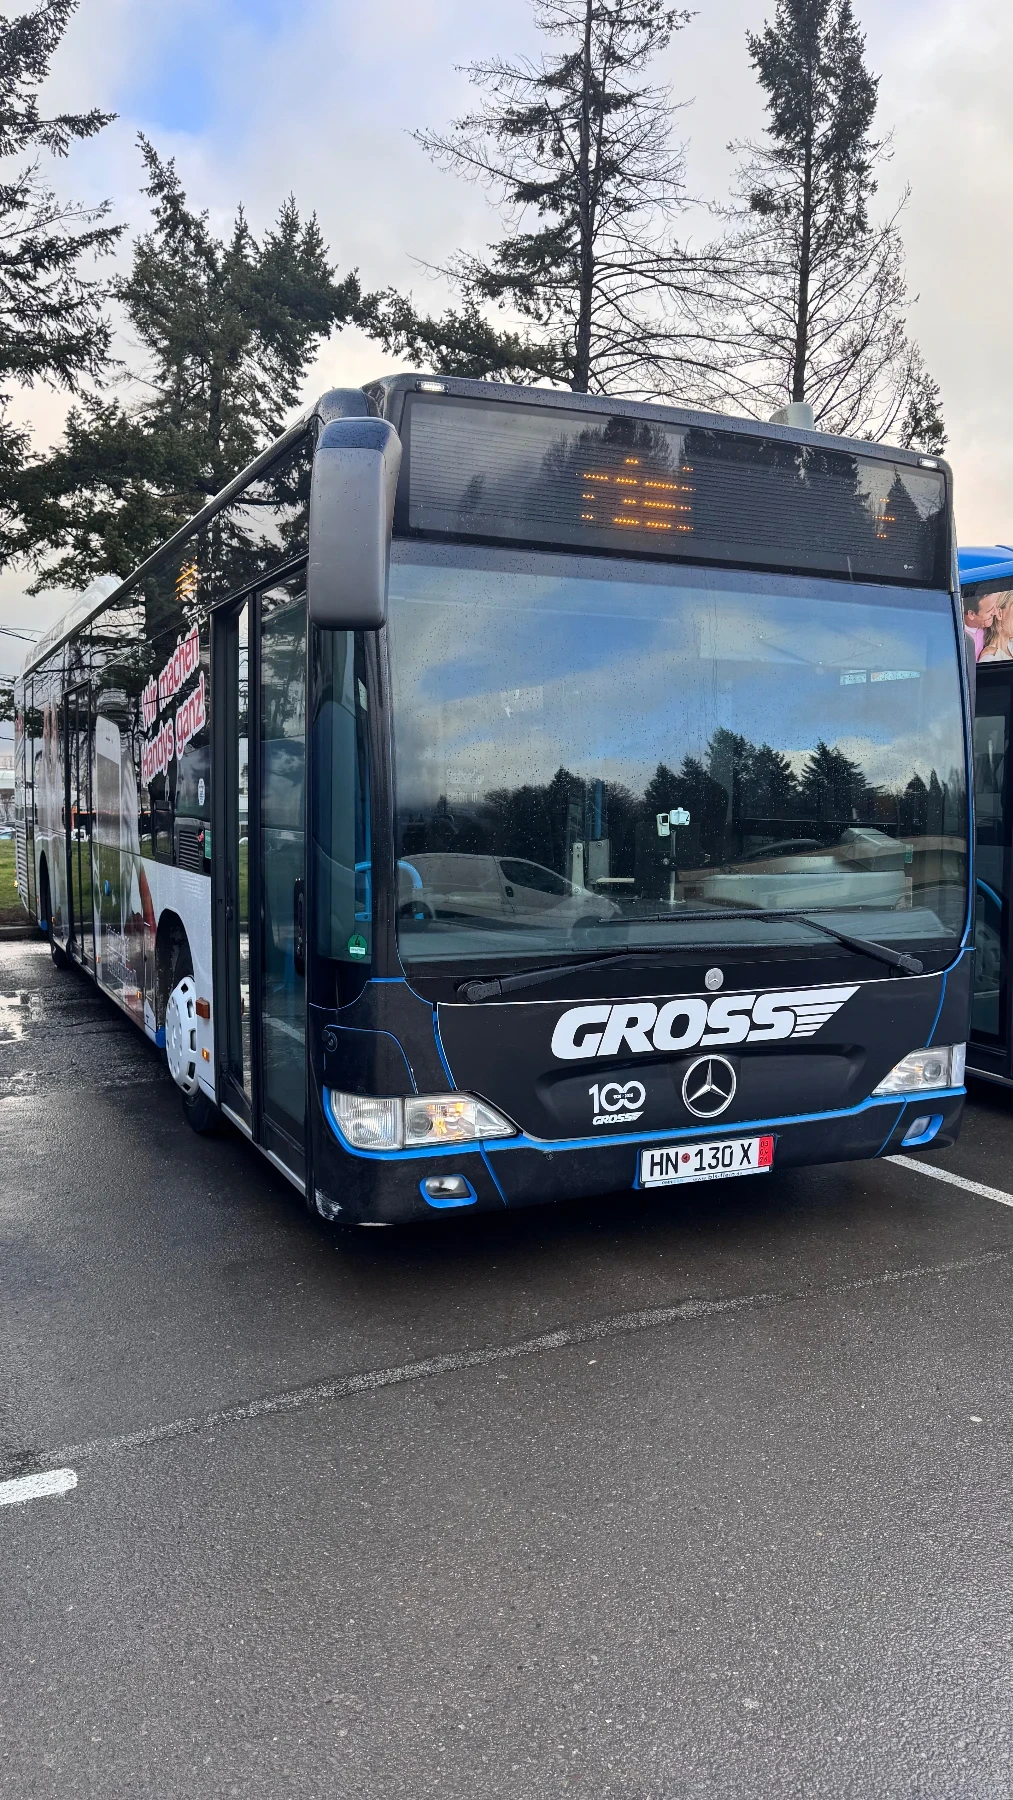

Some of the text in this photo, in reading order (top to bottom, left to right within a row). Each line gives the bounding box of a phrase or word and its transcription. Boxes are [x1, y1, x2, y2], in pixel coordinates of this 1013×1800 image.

[160, 625, 199, 710] machen
[142, 673, 205, 785] Handys ganz!
[551, 986, 860, 1060] GROSS
[589, 1080, 646, 1113] 100
[592, 1111, 644, 1125] GROSS
[650, 1142, 752, 1176] HN 130 X
